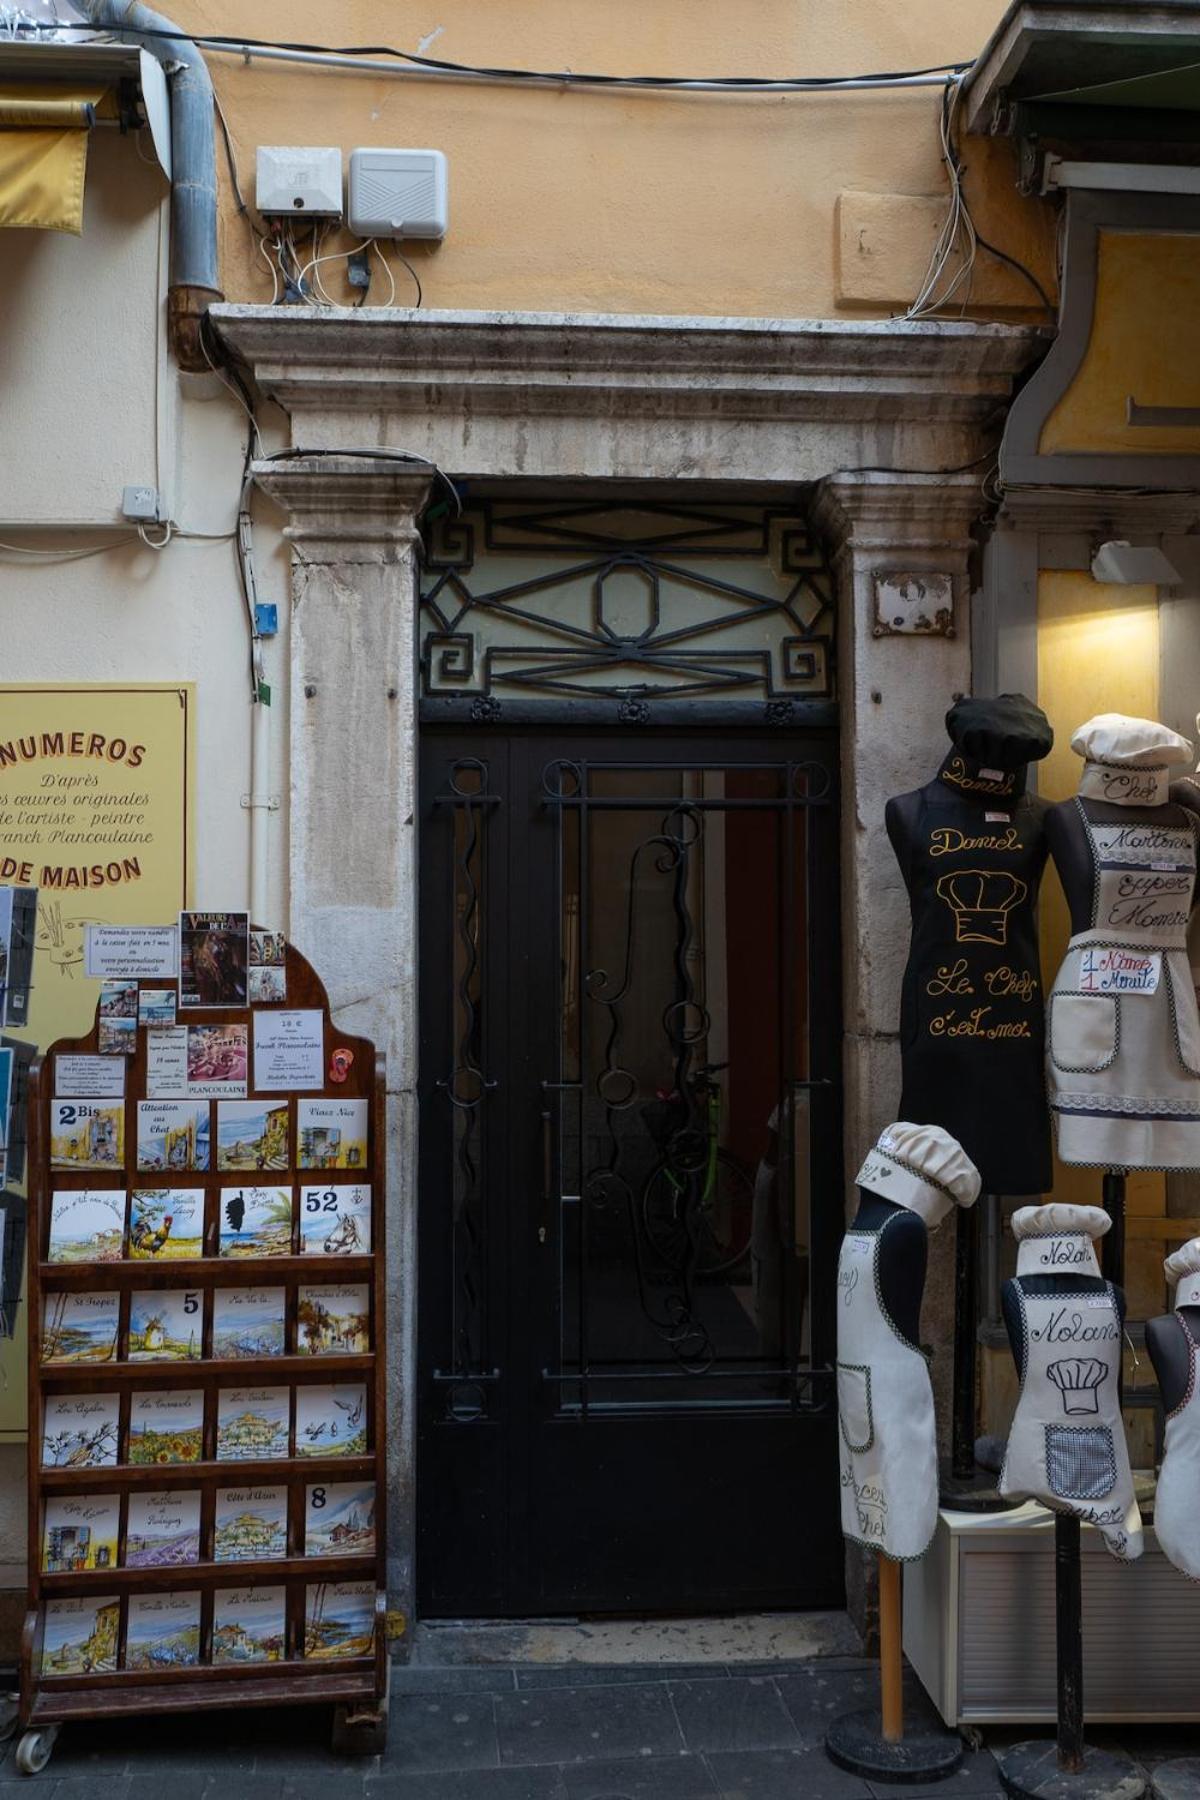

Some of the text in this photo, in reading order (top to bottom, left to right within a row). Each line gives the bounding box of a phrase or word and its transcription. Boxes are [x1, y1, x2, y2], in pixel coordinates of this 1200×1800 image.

[0, 733, 147, 767] NUMEROS
[41, 774, 98, 789] D'après
[942, 757, 1015, 796] Daniel
[1103, 773, 1158, 800] Chef
[73, 792, 149, 808] originales
[17, 811, 75, 825] l'artiste
[91, 813, 144, 828] peintre
[48, 830, 153, 844] Plancoulaine
[930, 827, 1022, 856] Daniel
[1100, 829, 1192, 849] Martine
[1, 857, 141, 887] DE MAISON
[1083, 951, 1151, 971] 1 Name
[926, 959, 1038, 1002] Le Chef
[1081, 969, 1157, 990] 1 Minute
[59, 1106, 100, 1125] 2 Bis
[140, 1103, 178, 1112] Attention
[150, 1126, 169, 1134] Chat
[306, 1192, 338, 1212] 52
[1040, 1241, 1092, 1265] Nolan
[184, 1294, 198, 1314] 5
[1031, 1307, 1119, 1343] Nolan
[312, 1488, 326, 1508] 8
